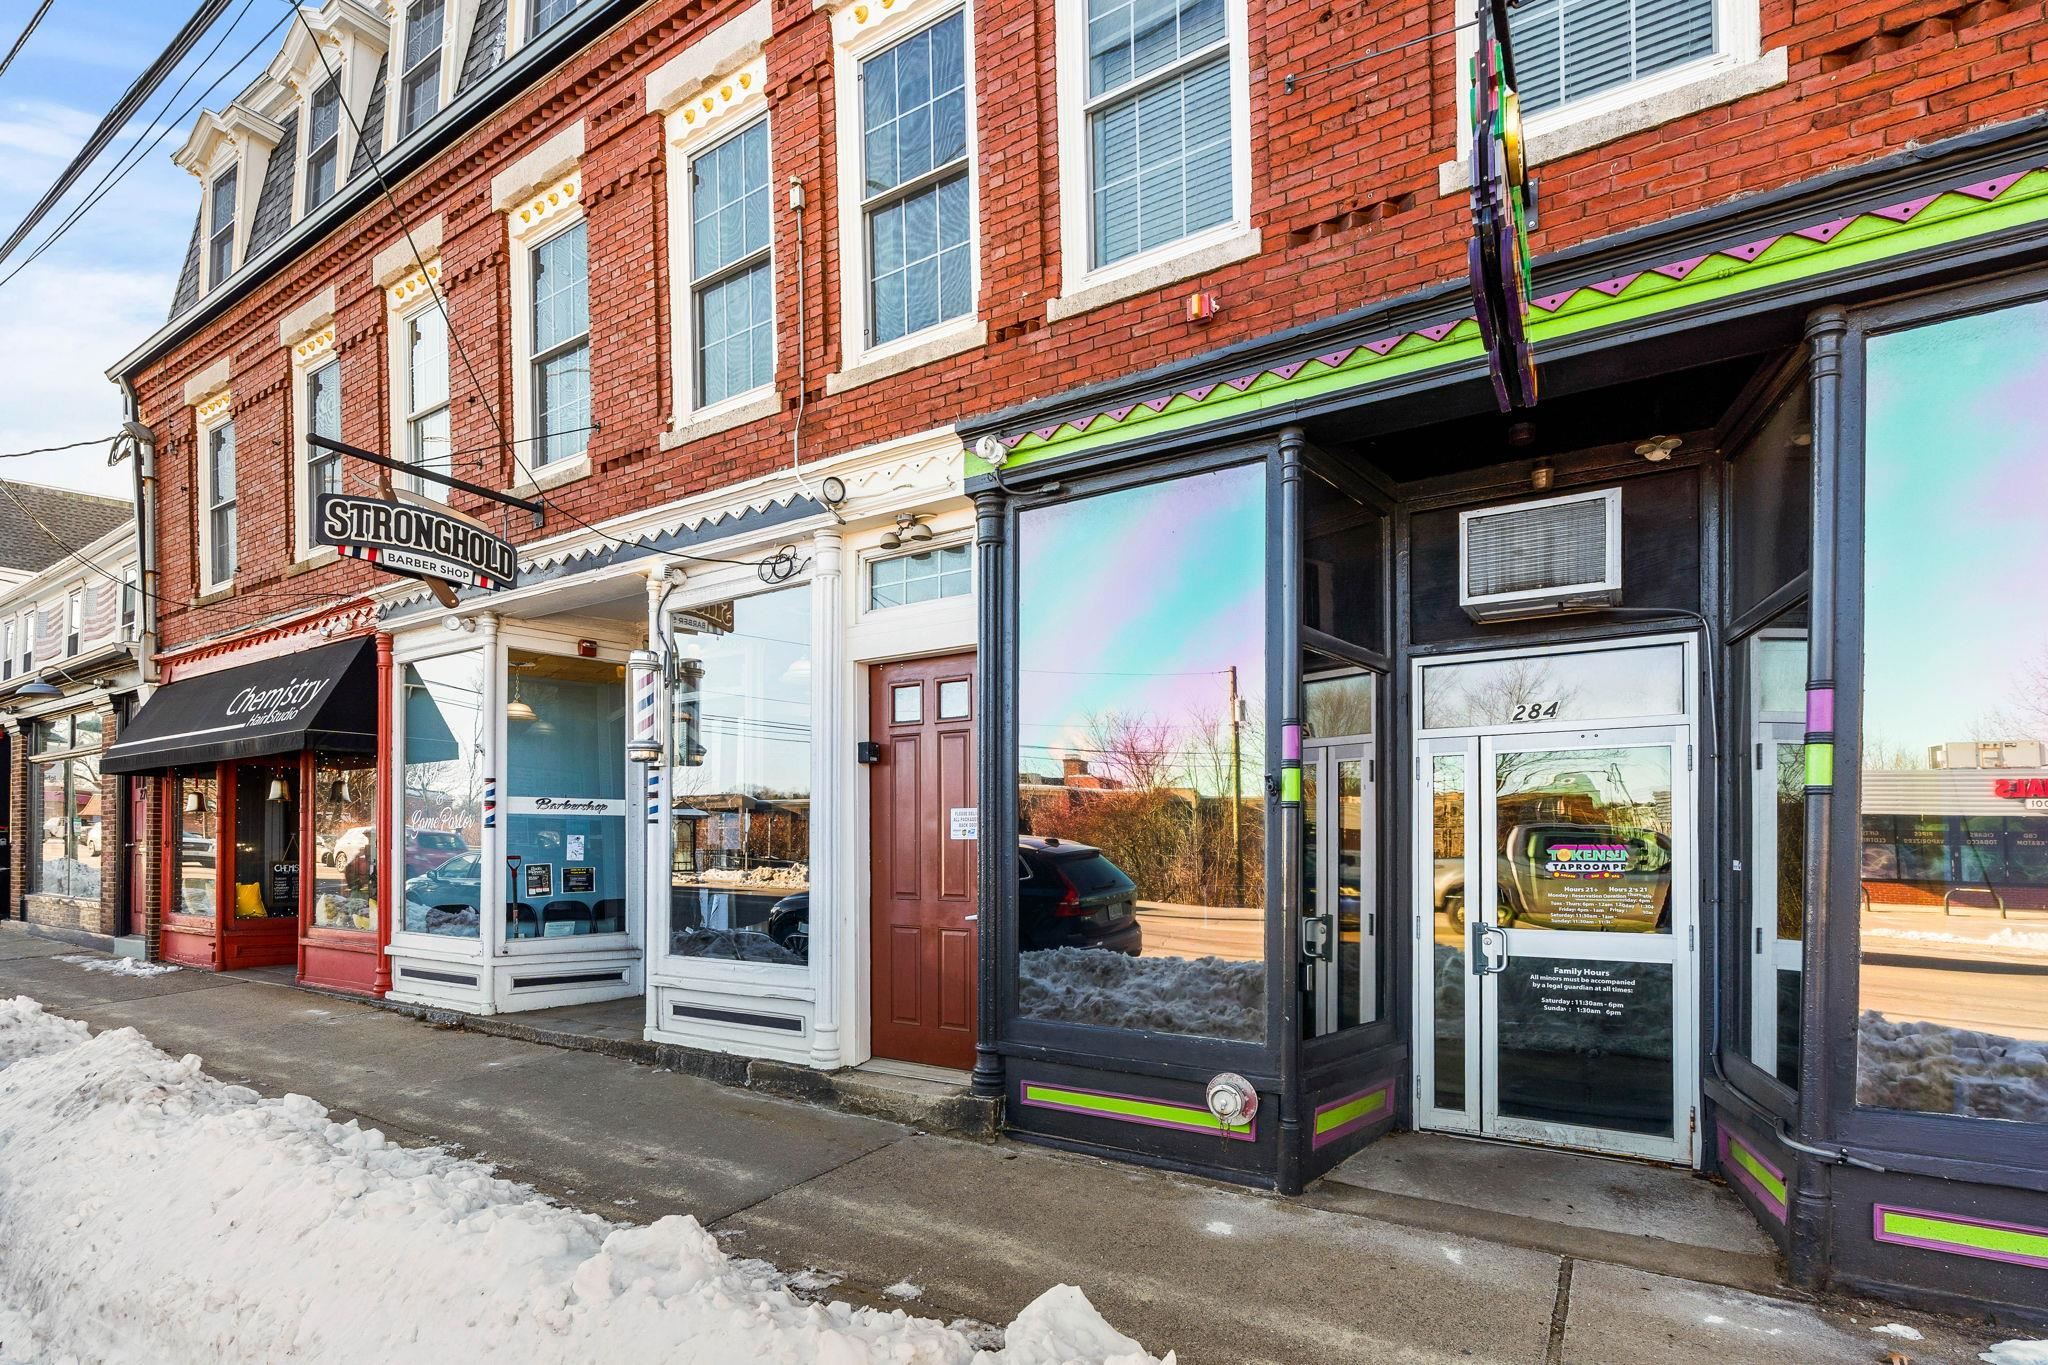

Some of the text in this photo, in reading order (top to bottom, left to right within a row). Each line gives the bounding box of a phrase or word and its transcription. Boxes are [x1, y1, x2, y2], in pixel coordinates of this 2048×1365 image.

[324, 499, 514, 582] STRONGHOLD
[388, 553, 470, 580] BARBER SHOP
[226, 678, 330, 716] Chemistry
[246, 707, 299, 728] Hair Studio
[1512, 701, 1559, 721] 284
[535, 797, 609, 814] Barbershop
[411, 806, 477, 840] Game Parlor
[1553, 863, 1611, 871] TAPROOM
[1553, 967, 1610, 977] Family Hours
[1532, 981, 1541, 989] by
[1546, 982, 1563, 990] legal
[1590, 978, 1636, 986] accompanied
[1541, 997, 1570, 1006] Saturday
[1574, 999, 1603, 1007] 11:30am
